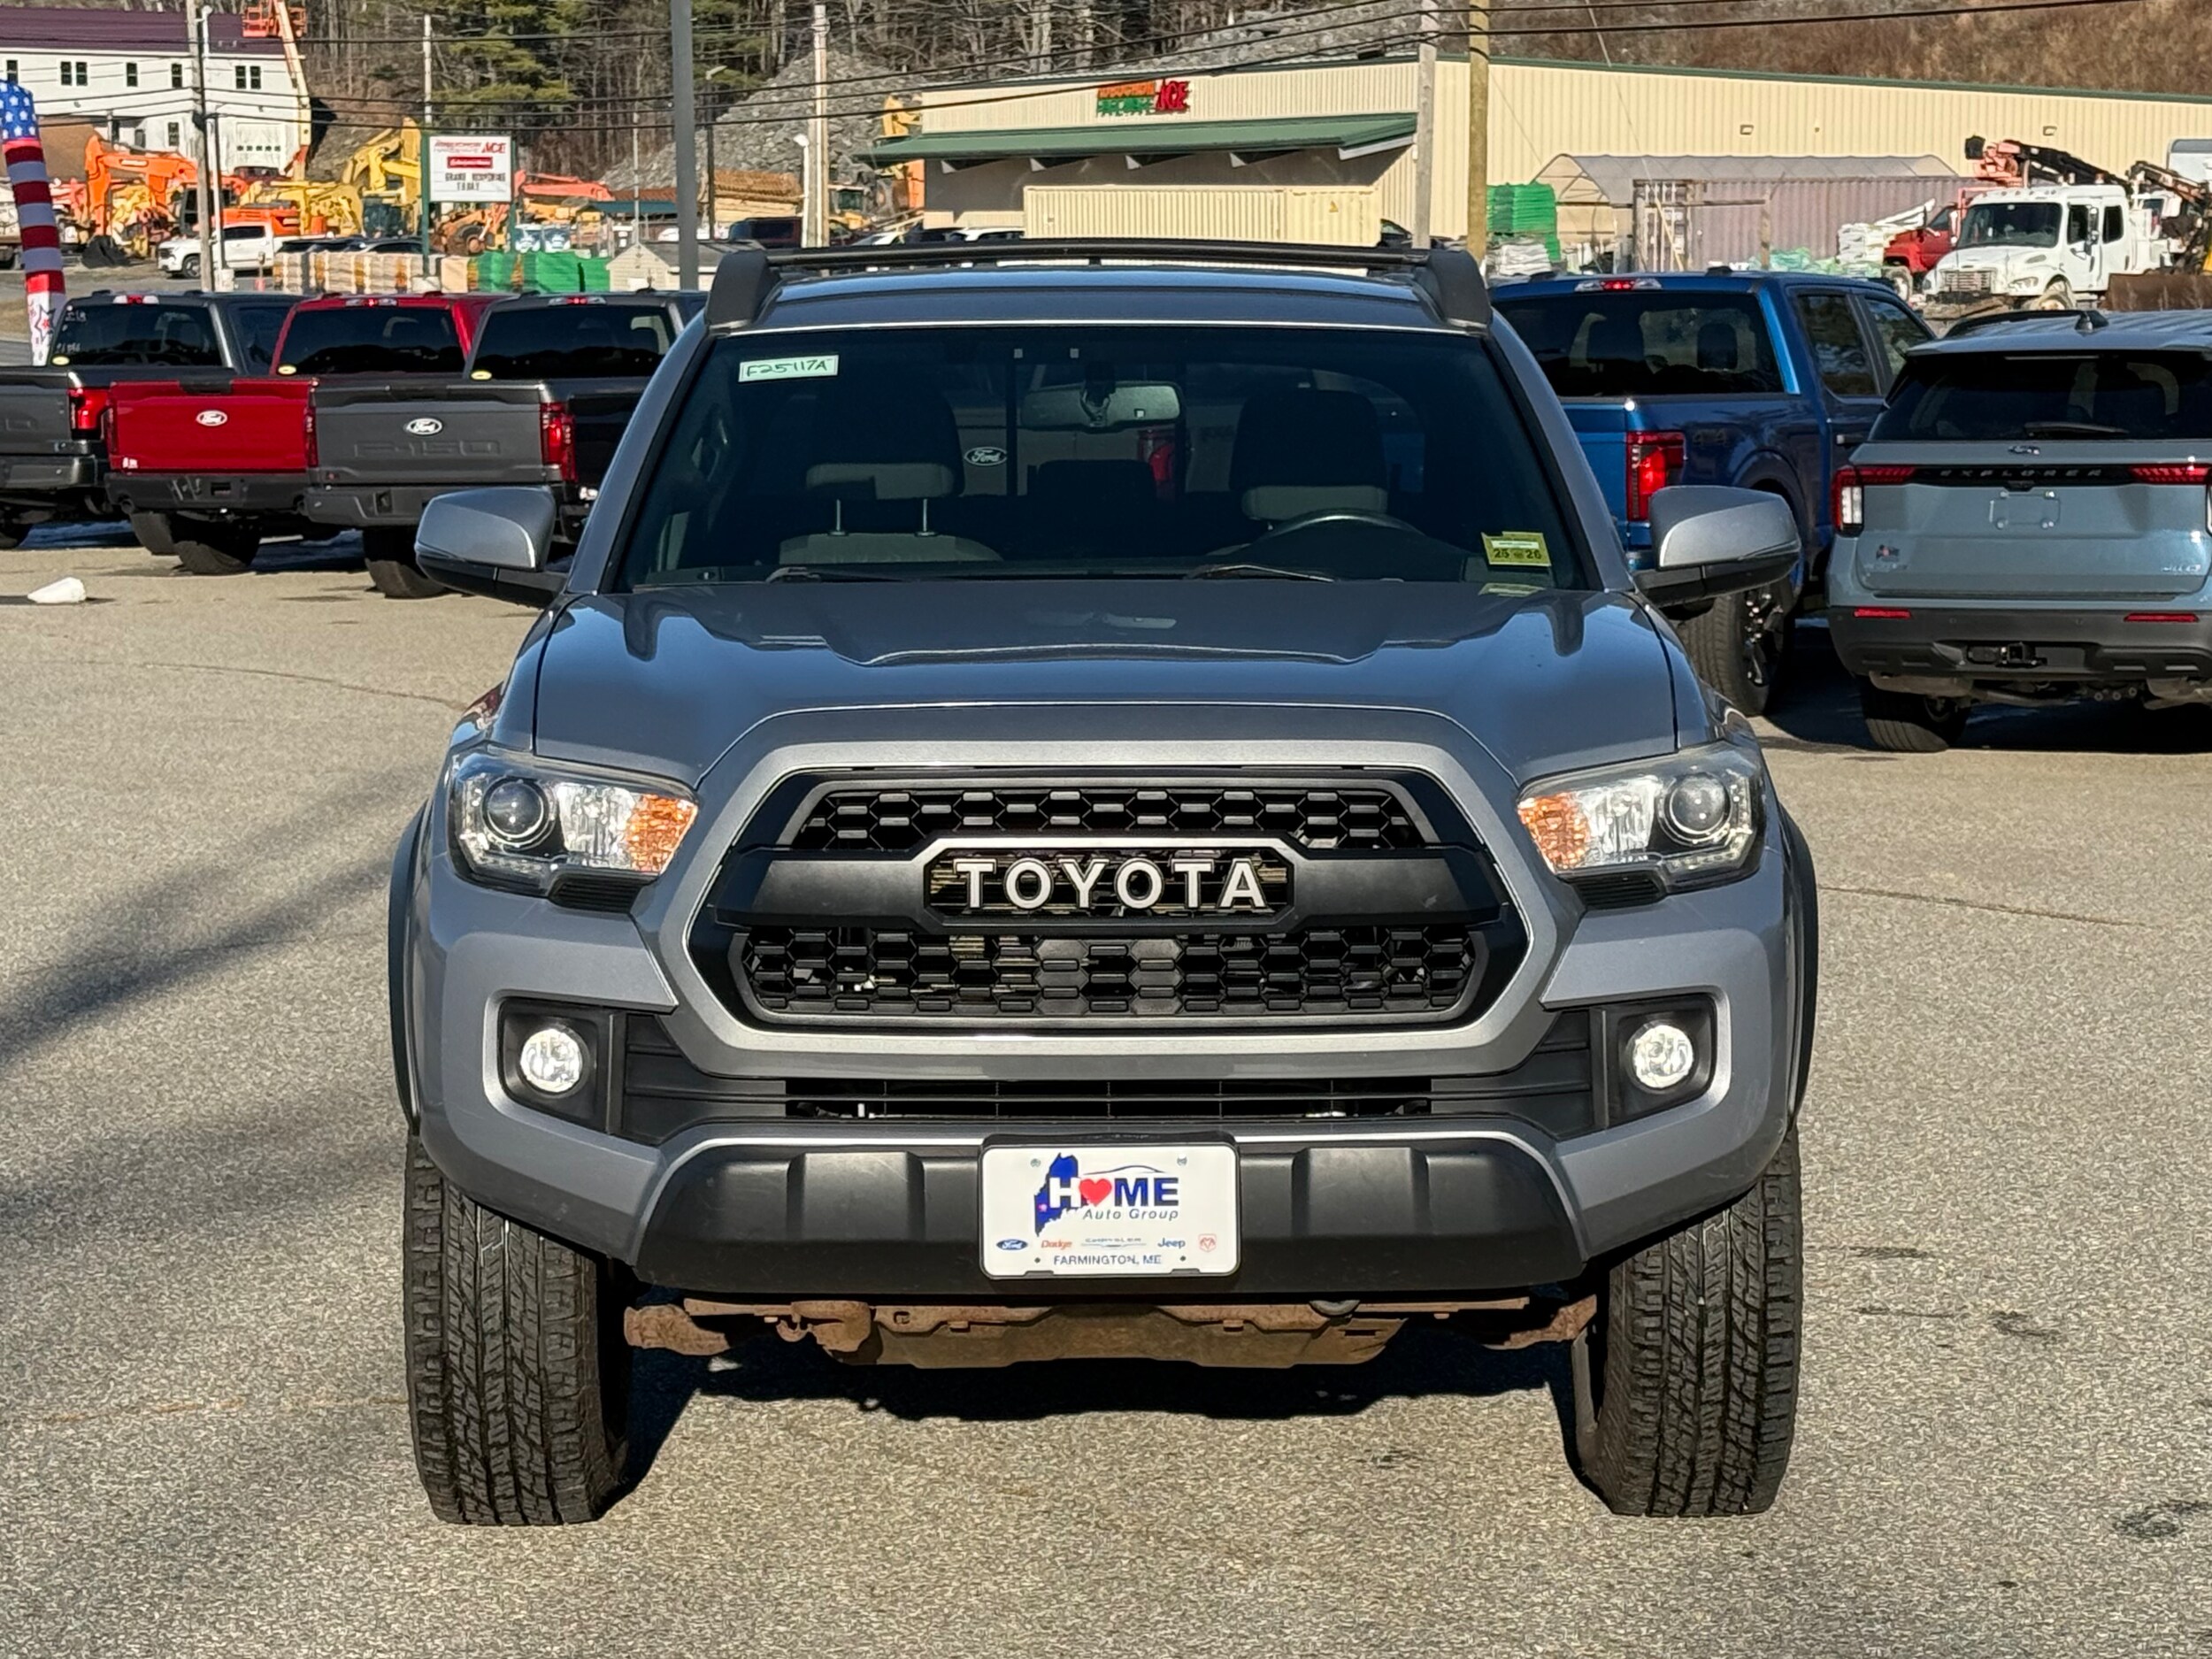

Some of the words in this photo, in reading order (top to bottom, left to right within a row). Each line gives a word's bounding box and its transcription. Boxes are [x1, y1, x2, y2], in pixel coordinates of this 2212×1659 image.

[1154, 79, 1190, 112] ACE
[481, 142, 506, 153] ACE
[953, 857, 1267, 910] TOYOTA
[1083, 1209, 1121, 1220] Auto
[1129, 1209, 1179, 1221] Group
[999, 1240, 1025, 1250] Ford
[1041, 1240, 1072, 1250] Dodge
[1157, 1238, 1186, 1249] Jeep
[1053, 1256, 1140, 1265] FARMINGTON,
[1143, 1255, 1162, 1264] ME
